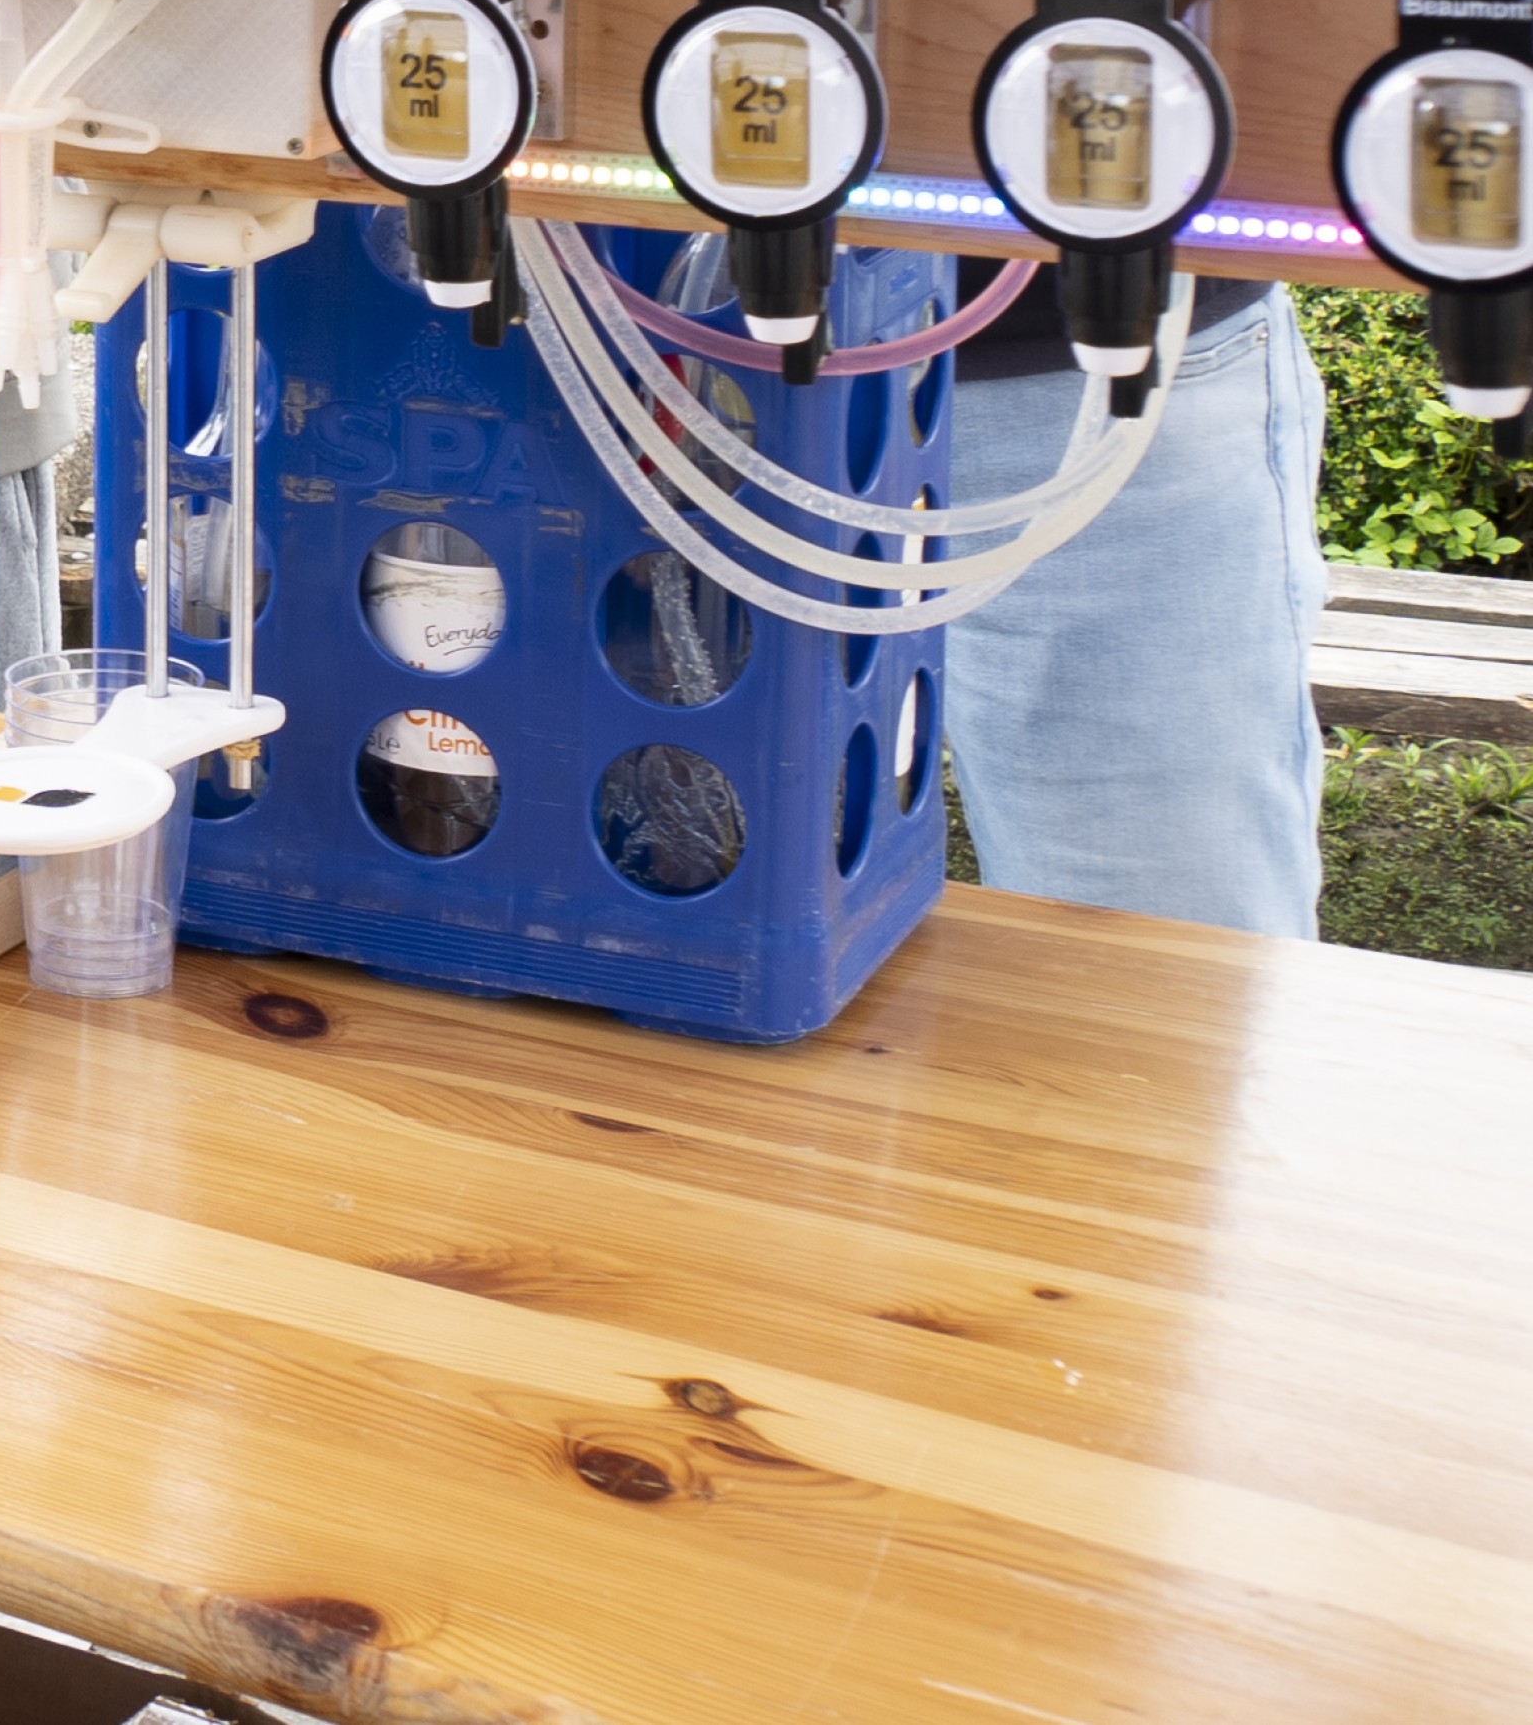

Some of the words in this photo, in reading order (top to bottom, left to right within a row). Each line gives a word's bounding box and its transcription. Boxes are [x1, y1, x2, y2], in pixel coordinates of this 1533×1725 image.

[399, 54, 447, 91] 25
[409, 96, 440, 118] ml
[733, 76, 787, 116] 25
[1070, 92, 1127, 132] 25
[743, 120, 778, 144] ml
[1081, 134, 1117, 163] ml
[1436, 128, 1497, 169] 25
[1448, 173, 1487, 202] ml
[312, 400, 571, 507] SPA
